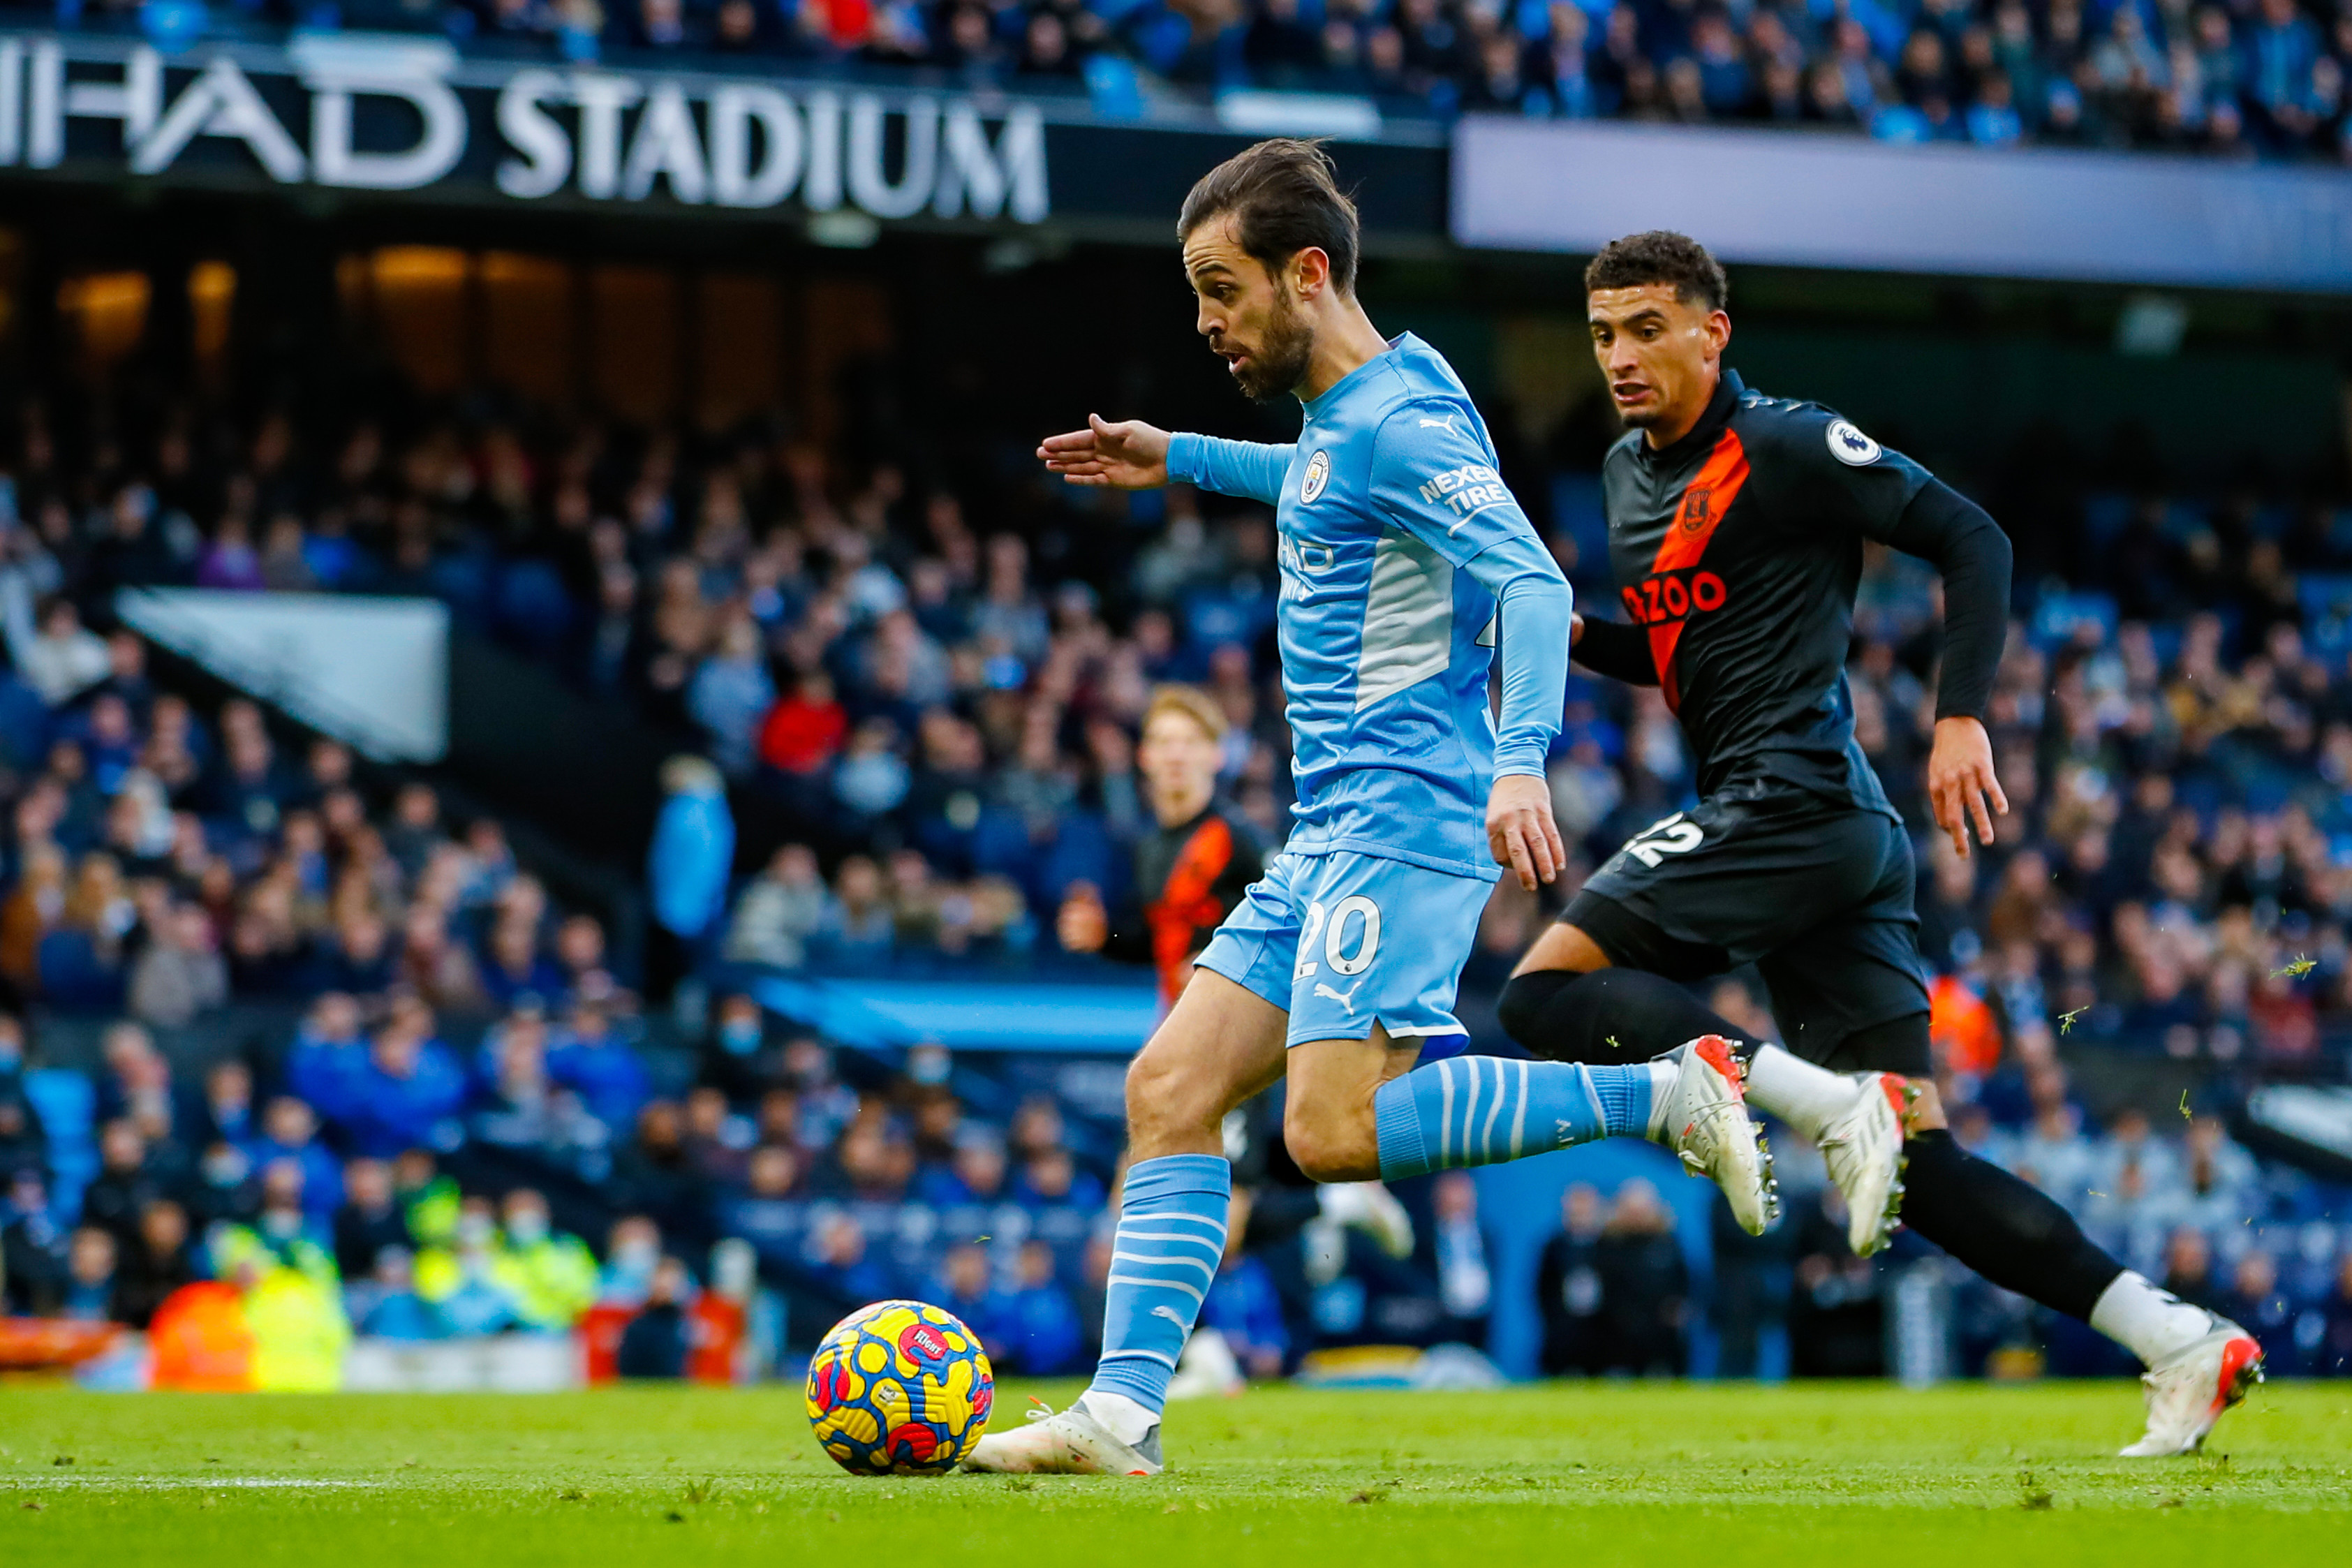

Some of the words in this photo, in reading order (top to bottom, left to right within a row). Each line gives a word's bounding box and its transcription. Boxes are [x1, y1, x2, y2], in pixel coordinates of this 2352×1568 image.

[495, 68, 1050, 225] STADIUM
[1444, 484, 1507, 516] TIRE
[1293, 895, 1382, 981] 20
